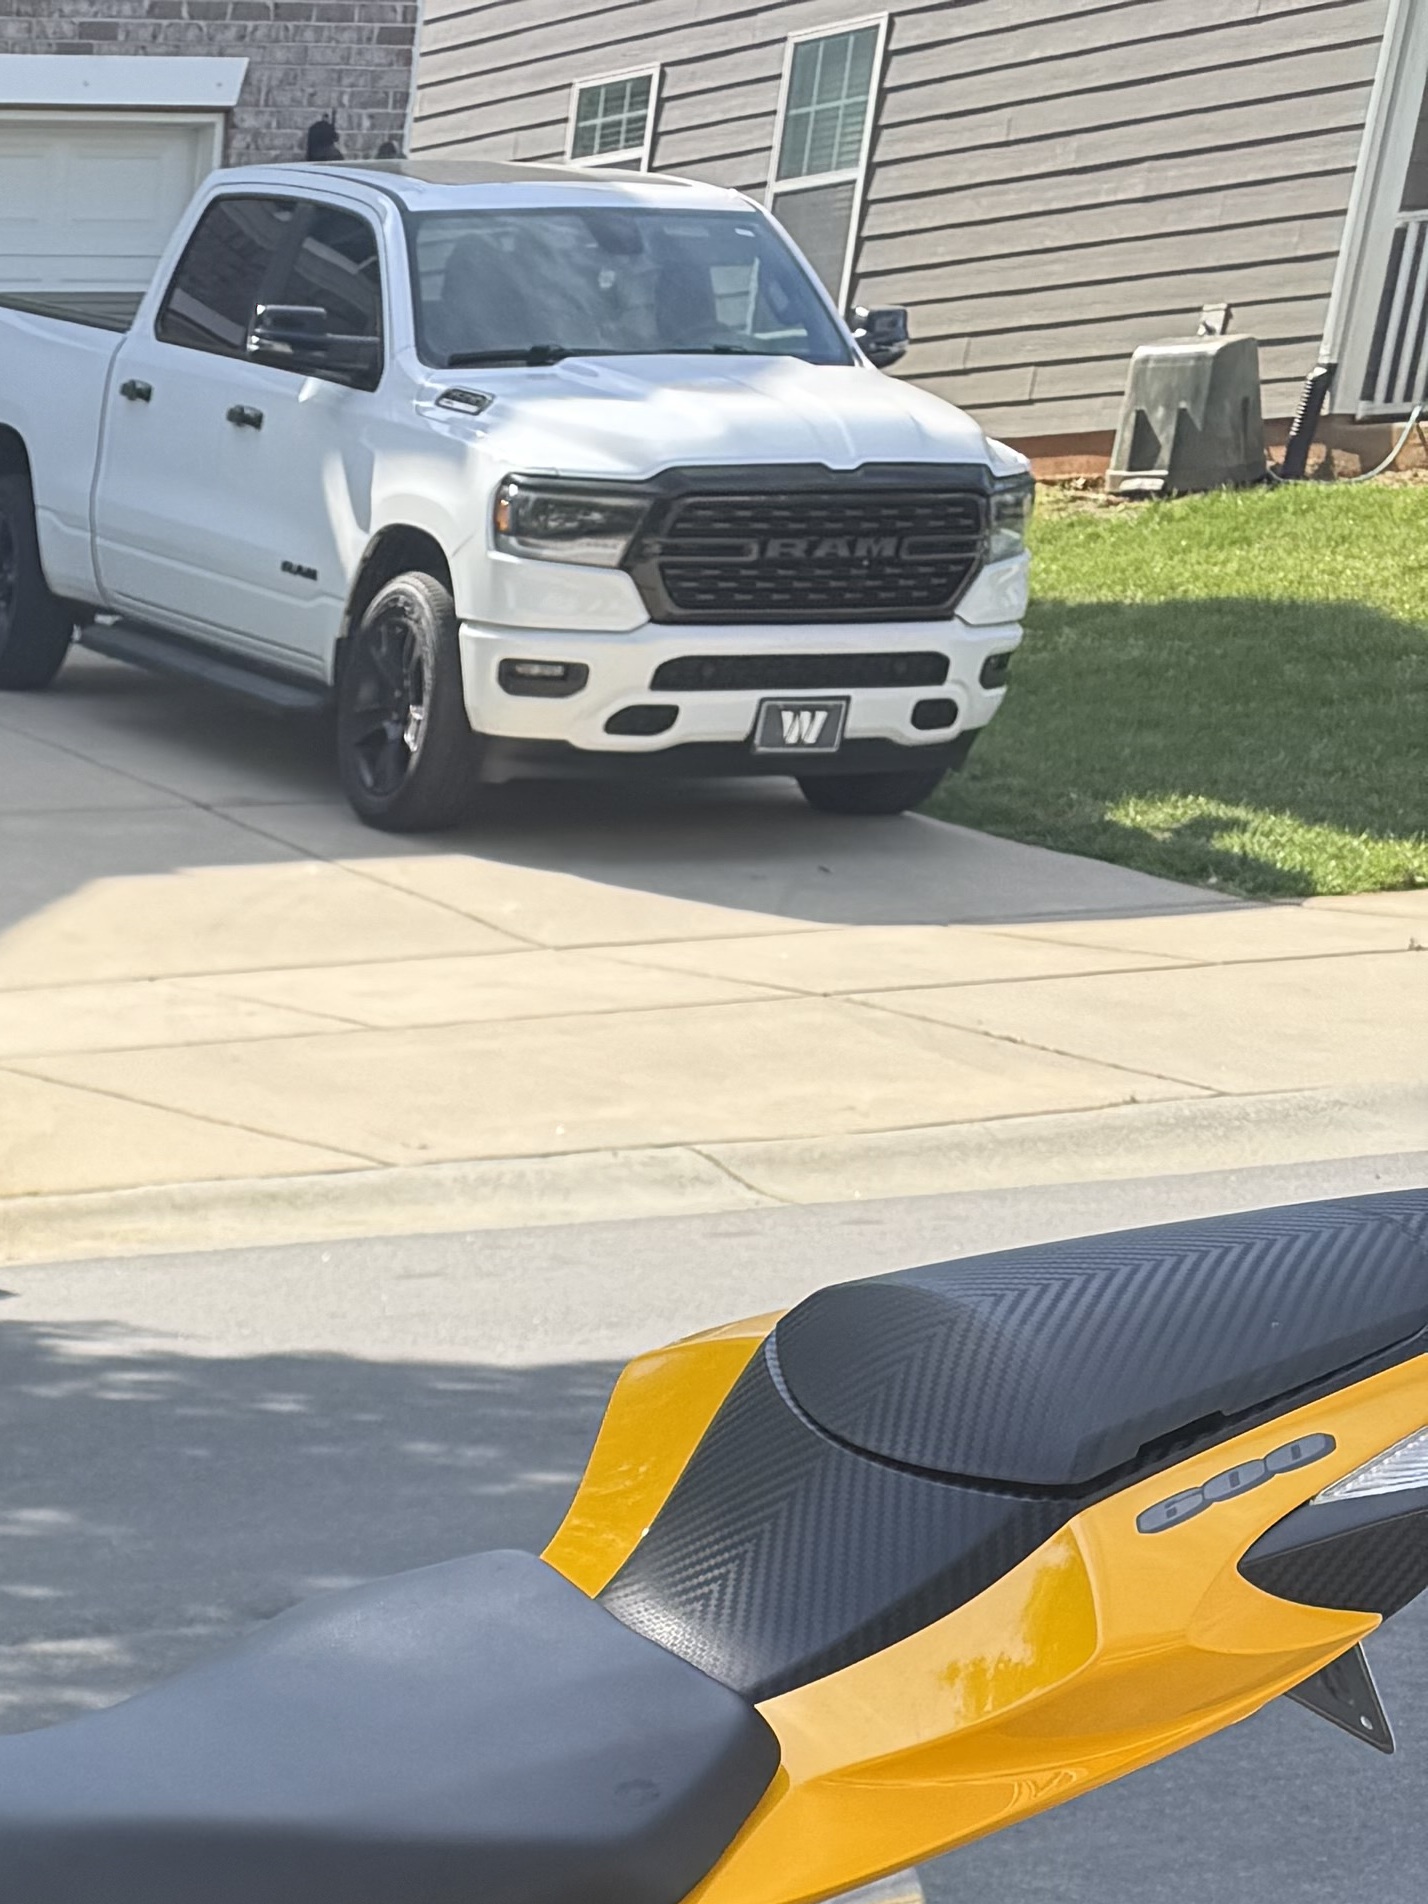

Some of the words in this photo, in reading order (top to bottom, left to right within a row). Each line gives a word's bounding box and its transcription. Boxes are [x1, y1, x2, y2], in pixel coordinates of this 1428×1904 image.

[764, 536, 898, 558] RAM
[780, 710, 828, 744] W
[1136, 1432, 1337, 1534] 600
